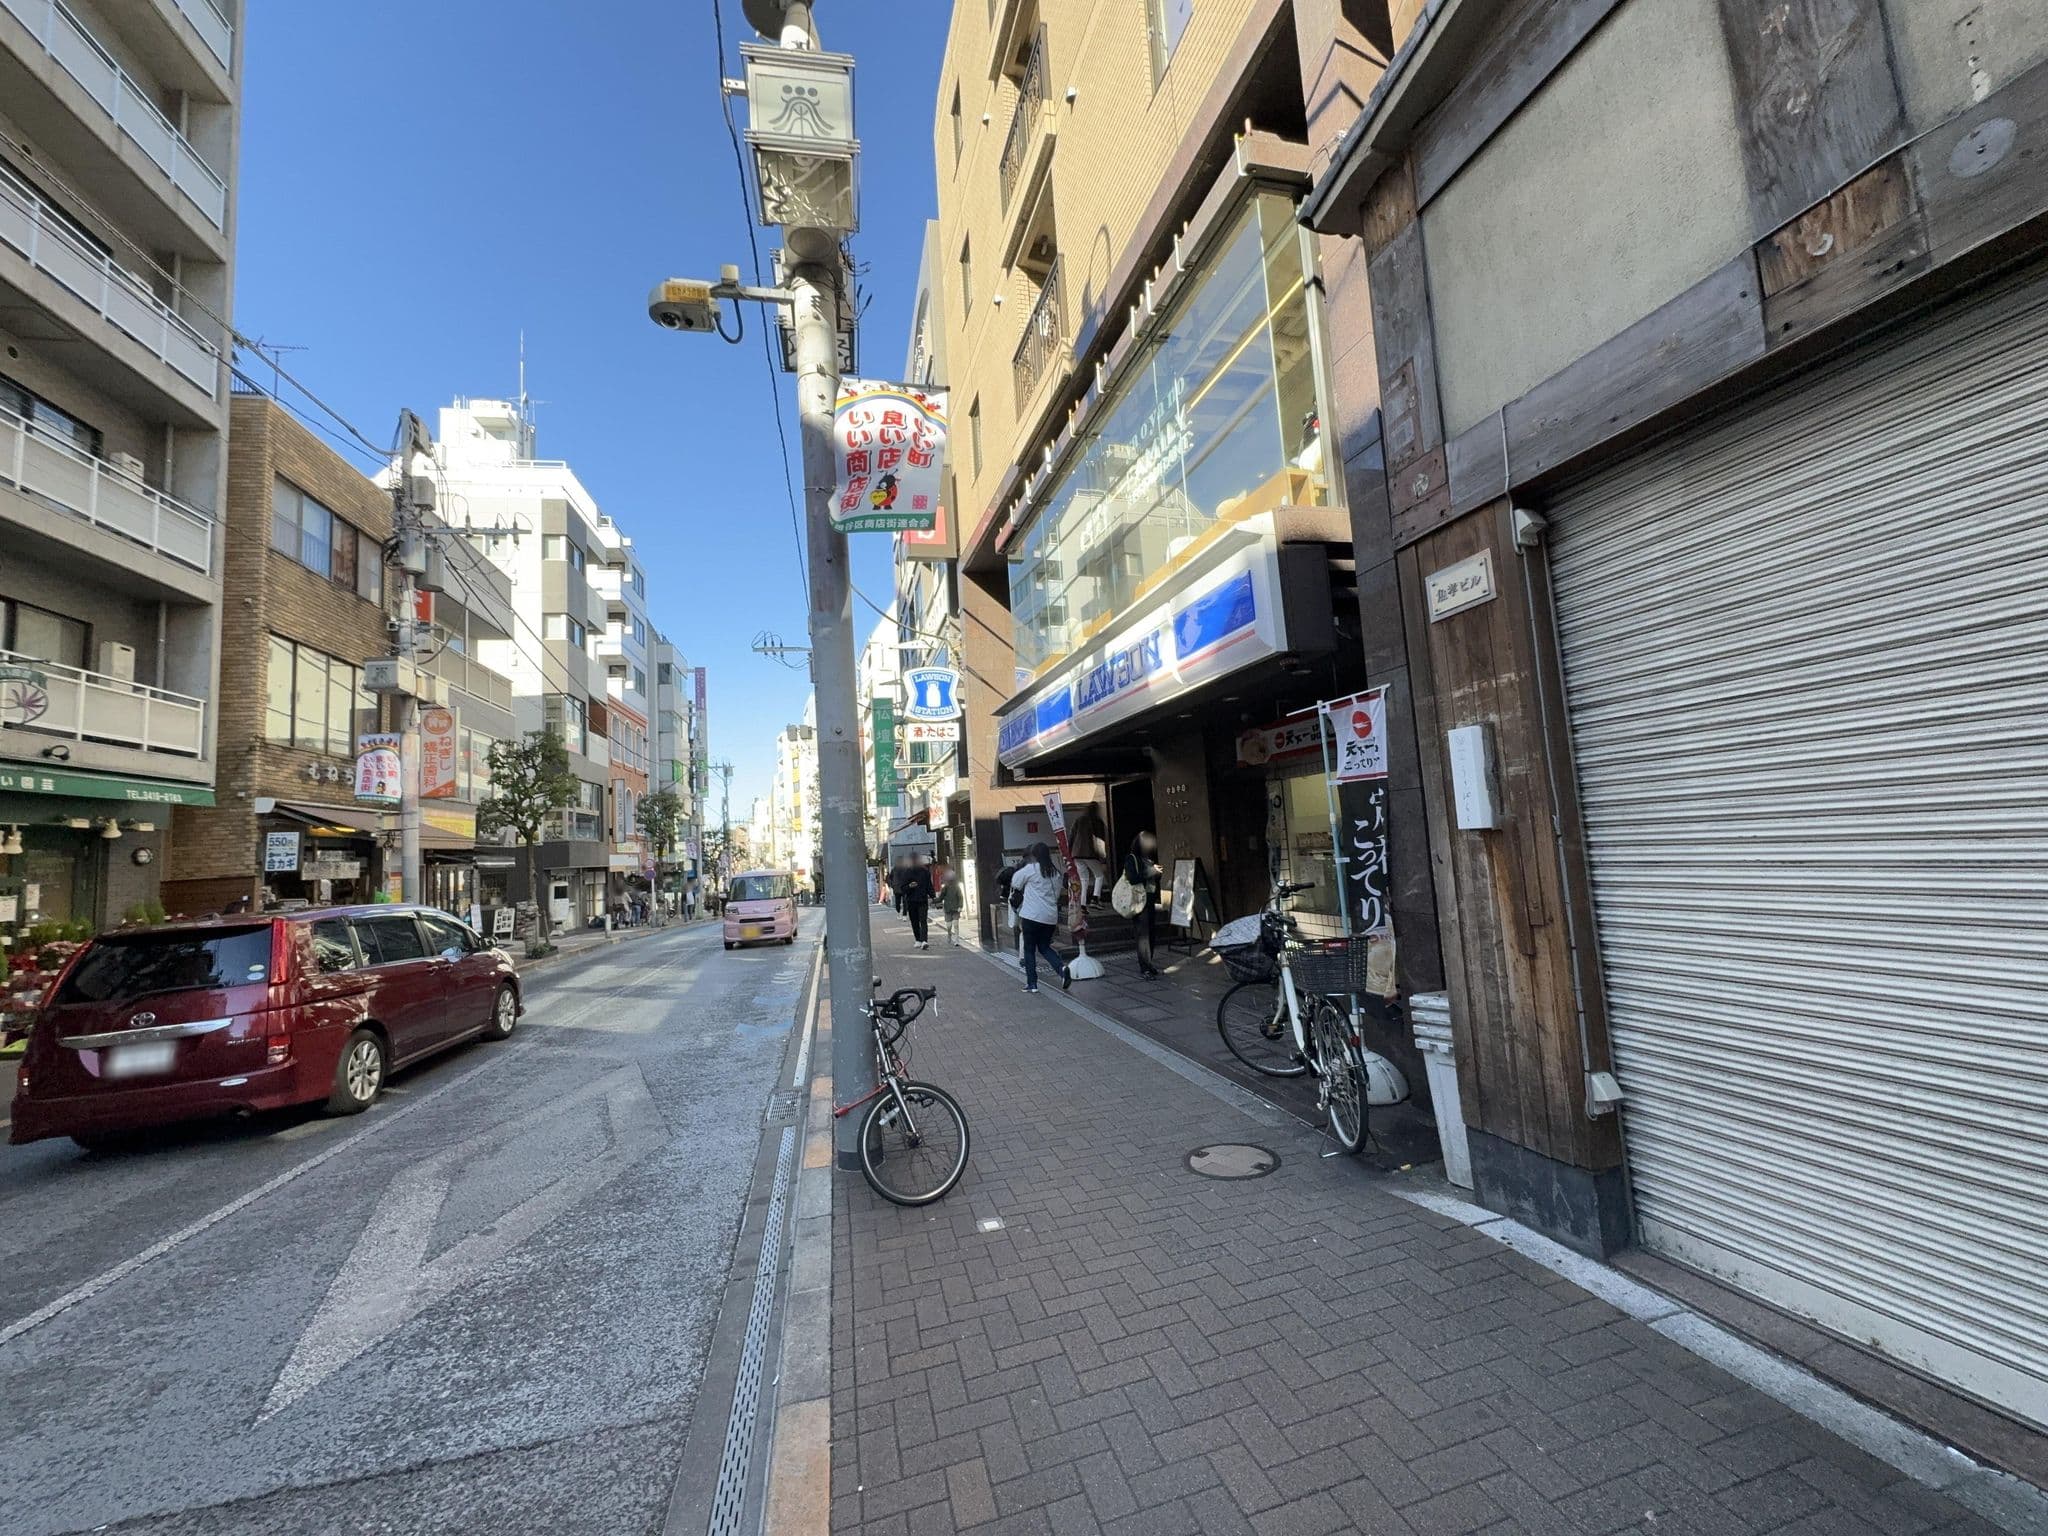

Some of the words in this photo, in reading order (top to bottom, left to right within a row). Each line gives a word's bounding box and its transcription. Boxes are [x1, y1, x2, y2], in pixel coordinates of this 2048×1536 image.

[840, 411, 873, 513] いい商店街
[877, 410, 907, 469] 良い店
[907, 418, 936, 468] いい町
[914, 673, 951, 682] LAWSON
[1078, 630, 1163, 709] LAWSON
[915, 705, 954, 716] STATION
[1351, 820, 1382, 935] こってり
